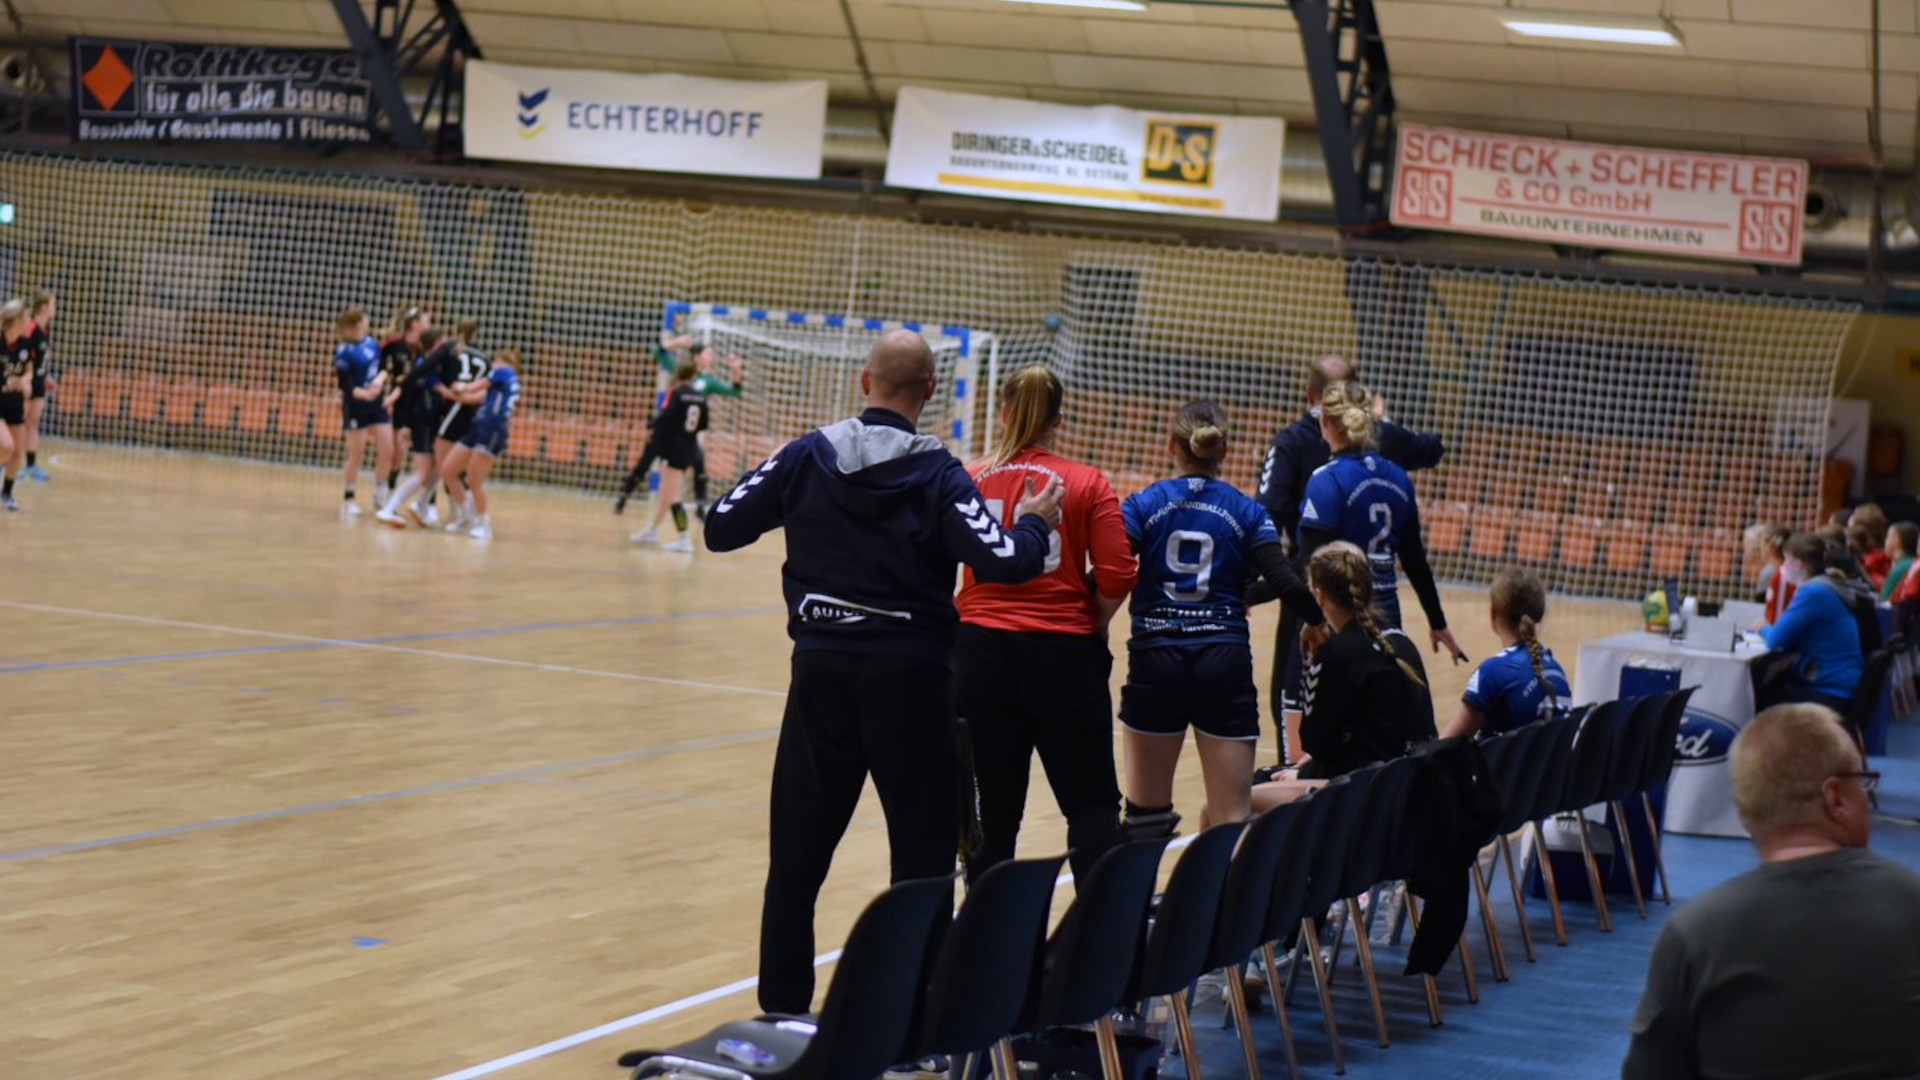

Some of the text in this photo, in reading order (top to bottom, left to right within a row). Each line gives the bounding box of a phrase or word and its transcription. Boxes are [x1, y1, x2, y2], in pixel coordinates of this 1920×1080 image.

[143, 44, 361, 86] Rothkege
[146, 79, 366, 117] für alle die bauen
[299, 118, 371, 142] Fliesen
[567, 102, 763, 138] ECHTERHOFF
[1404, 131, 1560, 178] SCHIECK
[1590, 153, 1798, 198] SCHEFFLER
[1495, 177, 1653, 213] & CO GmbH
[1480, 208, 1704, 245] BAUUNTERNEHMEN
[1368, 502, 1392, 560] 2
[1164, 530, 1214, 602] 9
